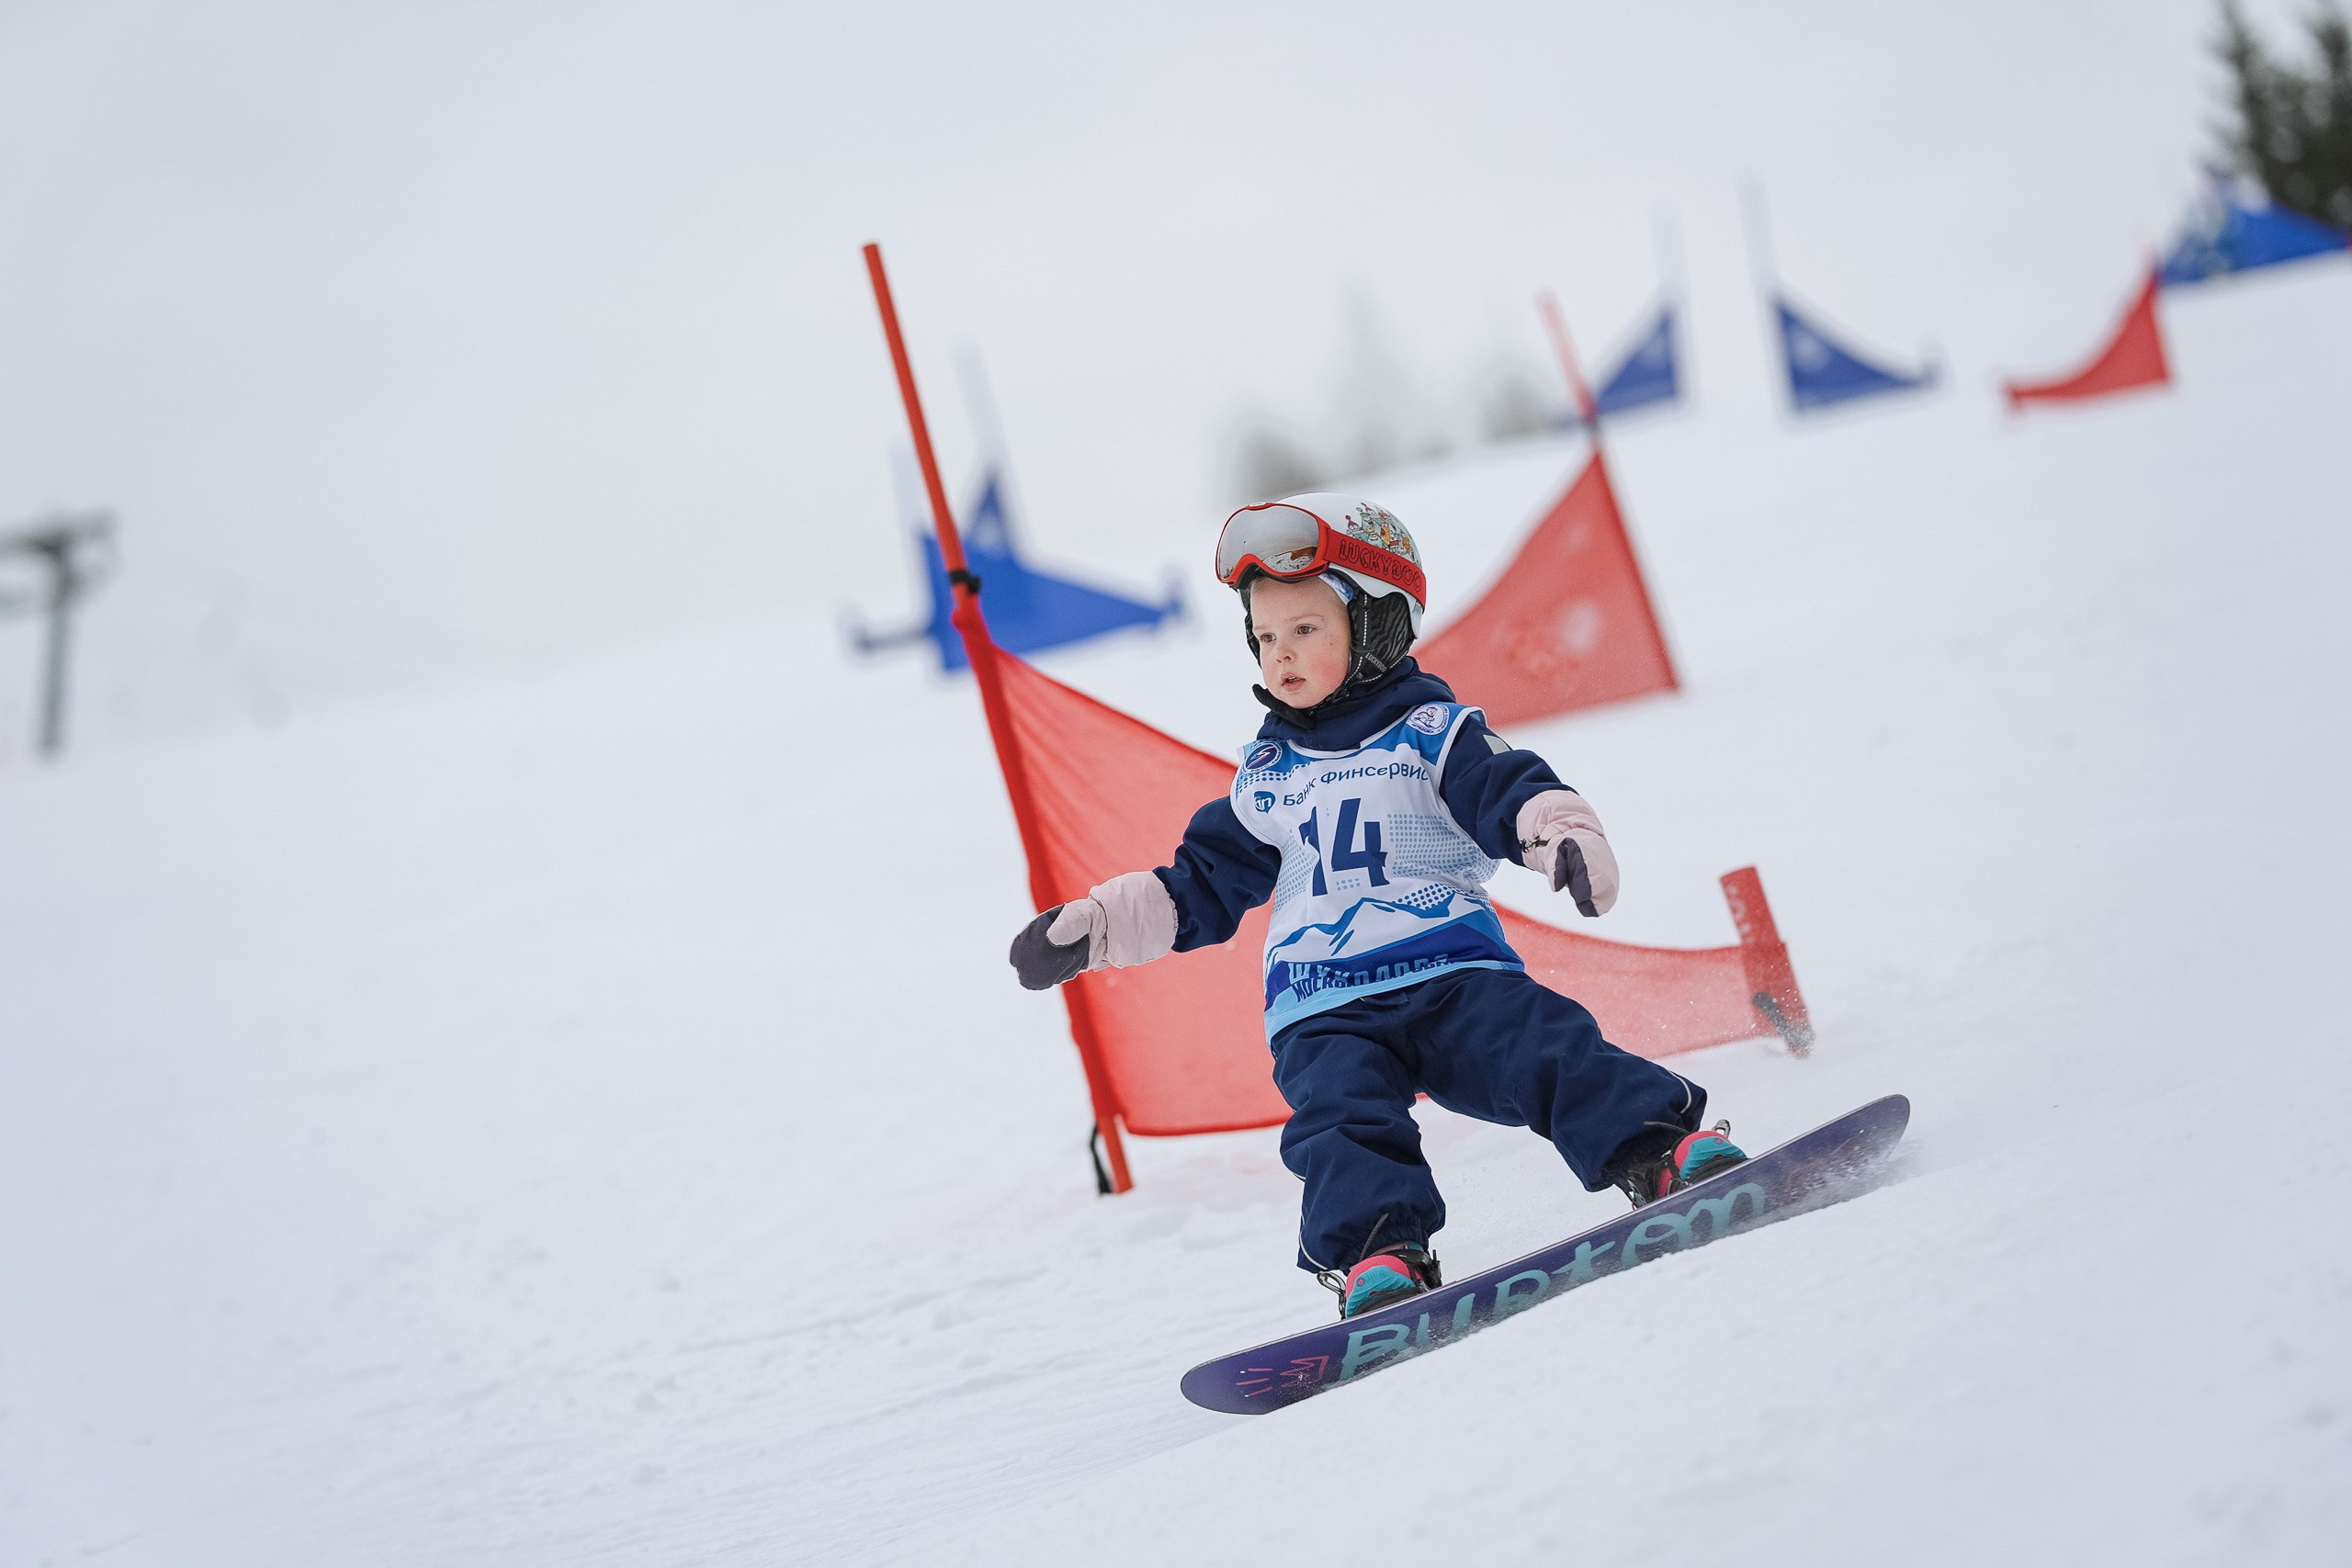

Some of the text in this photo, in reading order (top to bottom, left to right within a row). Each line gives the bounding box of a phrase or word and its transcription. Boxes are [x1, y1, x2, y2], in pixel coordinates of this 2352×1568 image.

[1339, 539, 1421, 593] LUCKYBOO
[1283, 778, 1317, 807] Банк
[1298, 797, 1390, 897] 14
